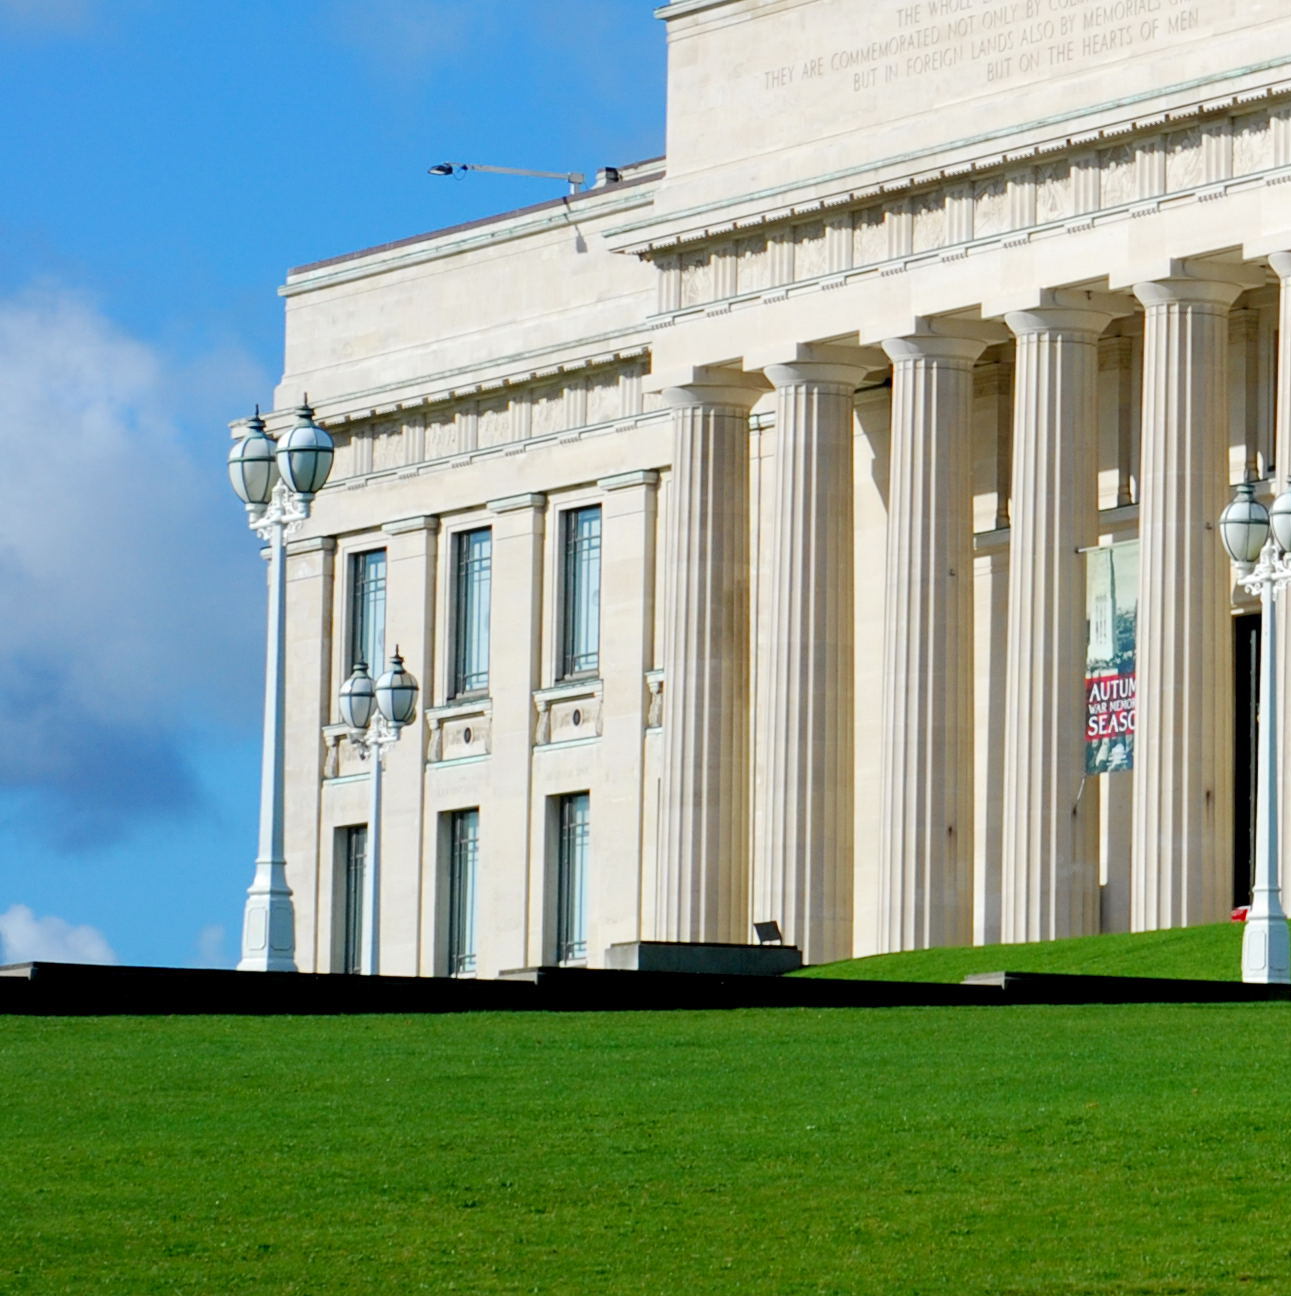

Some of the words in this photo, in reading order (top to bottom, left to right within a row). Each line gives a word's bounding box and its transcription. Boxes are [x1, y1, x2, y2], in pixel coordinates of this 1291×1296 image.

[764, 64, 794, 90] THEY
[801, 56, 824, 80] ARE
[831, 26, 940, 71] COMMEMORATED
[948, 15, 976, 40] NOT
[982, 3, 1017, 30] ONLY
[853, 67, 878, 92] BUT
[884, 64, 898, 83] IN
[906, 44, 963, 77] FOREIGN
[972, 30, 1014, 60] LANDS
[1020, 20, 1054, 47] ALSO
[1060, 14, 1076, 36] BY
[896, 4, 920, 27] THE
[987, 57, 1012, 82] BUT
[1020, 47, 1040, 72] ON
[1048, 41, 1074, 65] THE
[1082, 25, 1133, 56] HEARTS
[1140, 18, 1160, 41] OF
[1168, 7, 1199, 34] MEN
[1088, 702, 1107, 715] WAR
